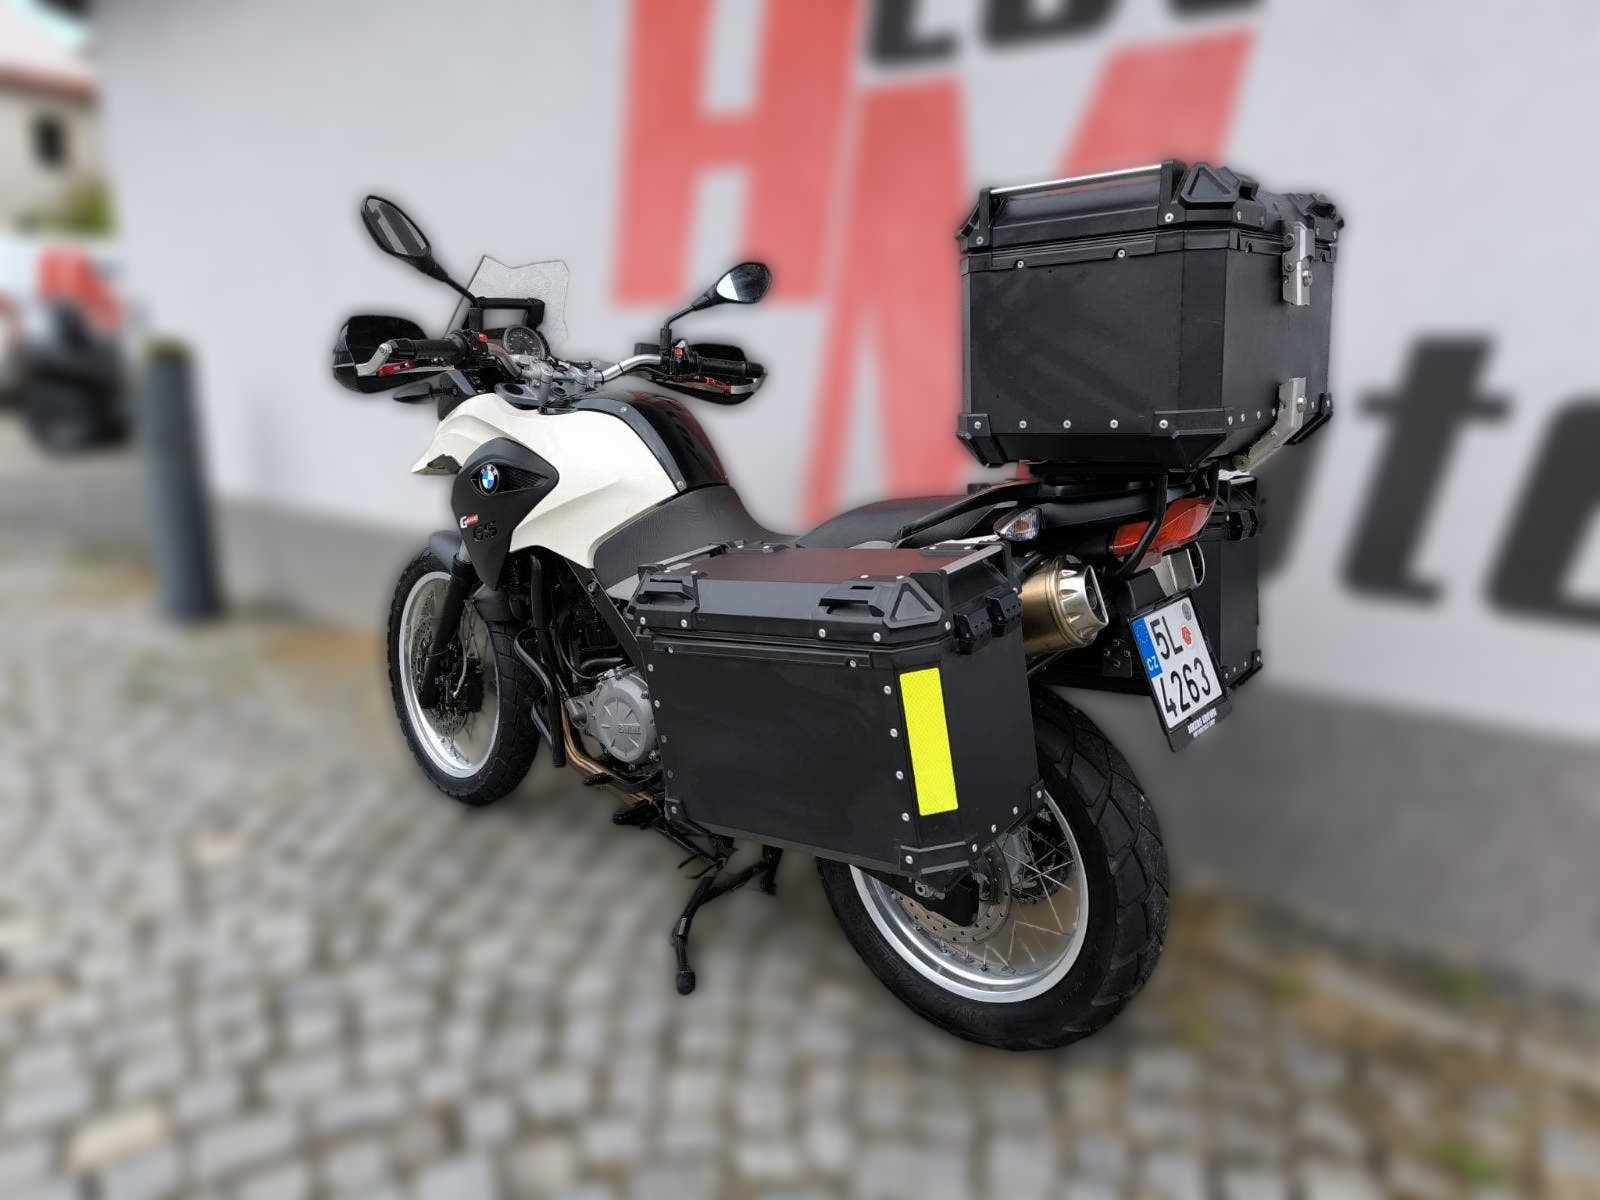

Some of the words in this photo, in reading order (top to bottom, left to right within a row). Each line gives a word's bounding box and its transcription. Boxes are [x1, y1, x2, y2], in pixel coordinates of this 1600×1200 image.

[1150, 616, 1184, 660] 5L
[1146, 655, 1159, 672] CZ
[1160, 657, 1211, 717] 4263
